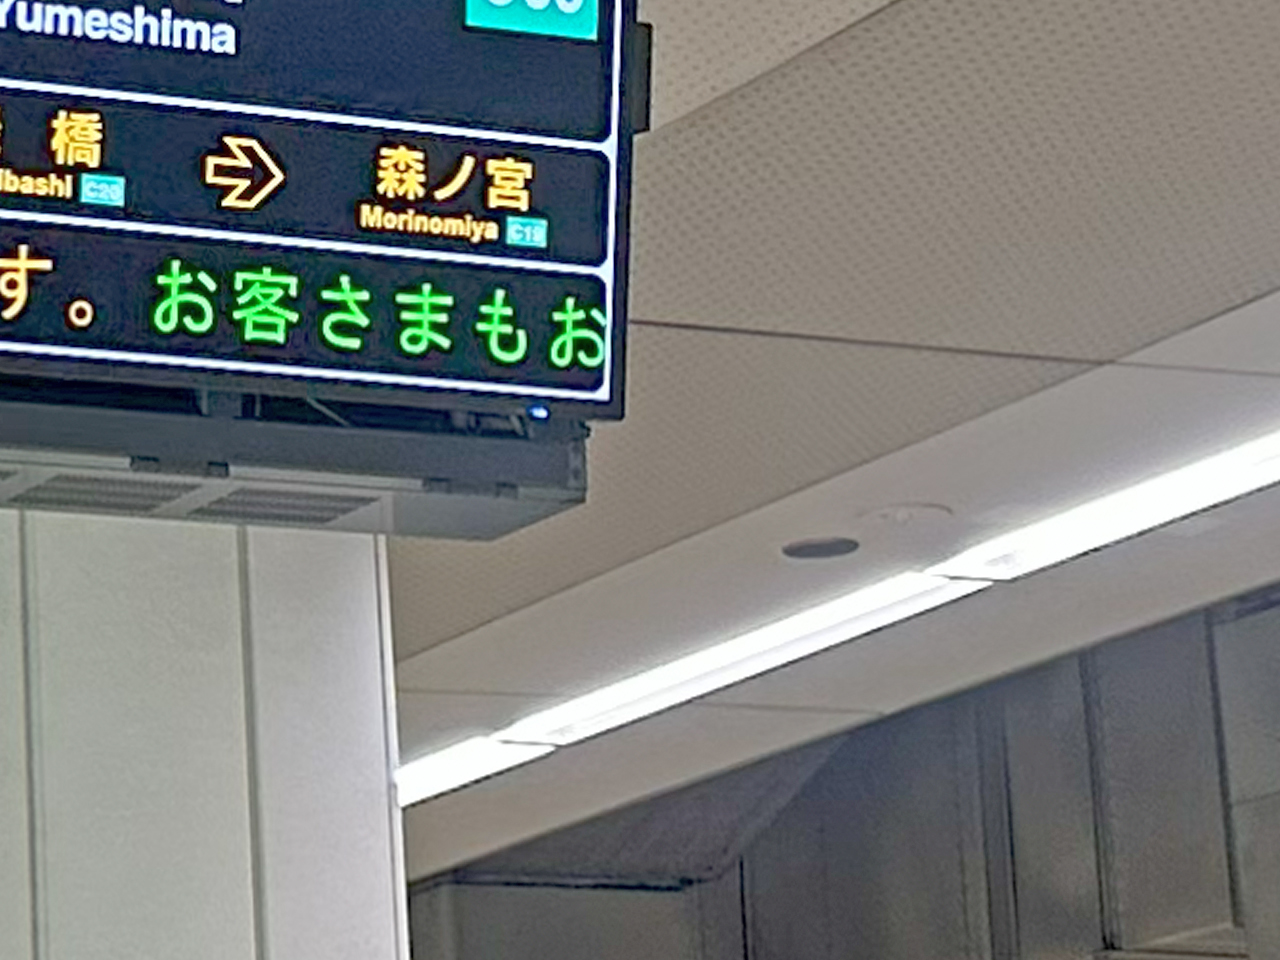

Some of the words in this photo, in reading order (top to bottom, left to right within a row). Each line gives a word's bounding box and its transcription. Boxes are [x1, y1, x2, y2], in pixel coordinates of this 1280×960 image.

[376, 145, 534, 212] 森ノ宮
[359, 203, 500, 244] Morinomiya
